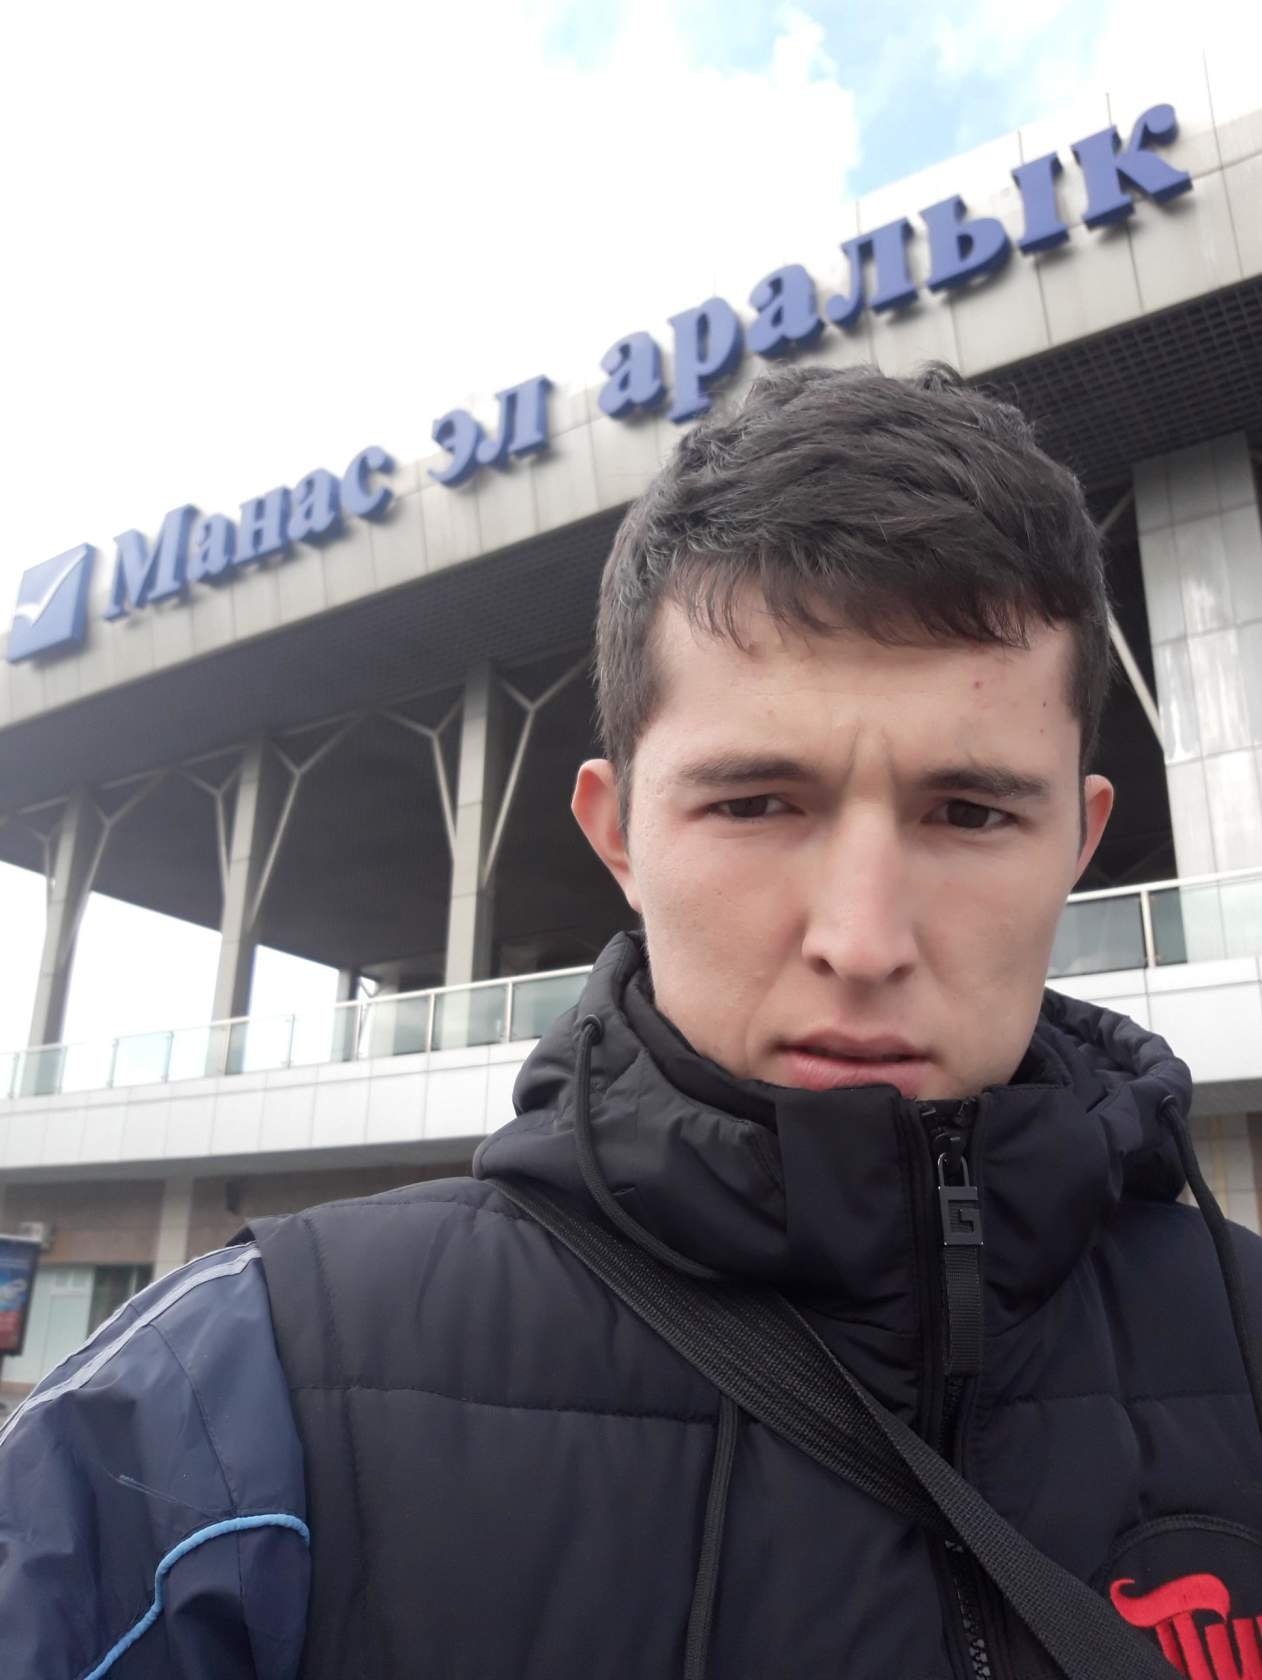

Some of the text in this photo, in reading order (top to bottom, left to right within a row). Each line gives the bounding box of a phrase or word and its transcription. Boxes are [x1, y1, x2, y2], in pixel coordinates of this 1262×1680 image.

[105, 103, 1193, 622] Манас эл аралык
